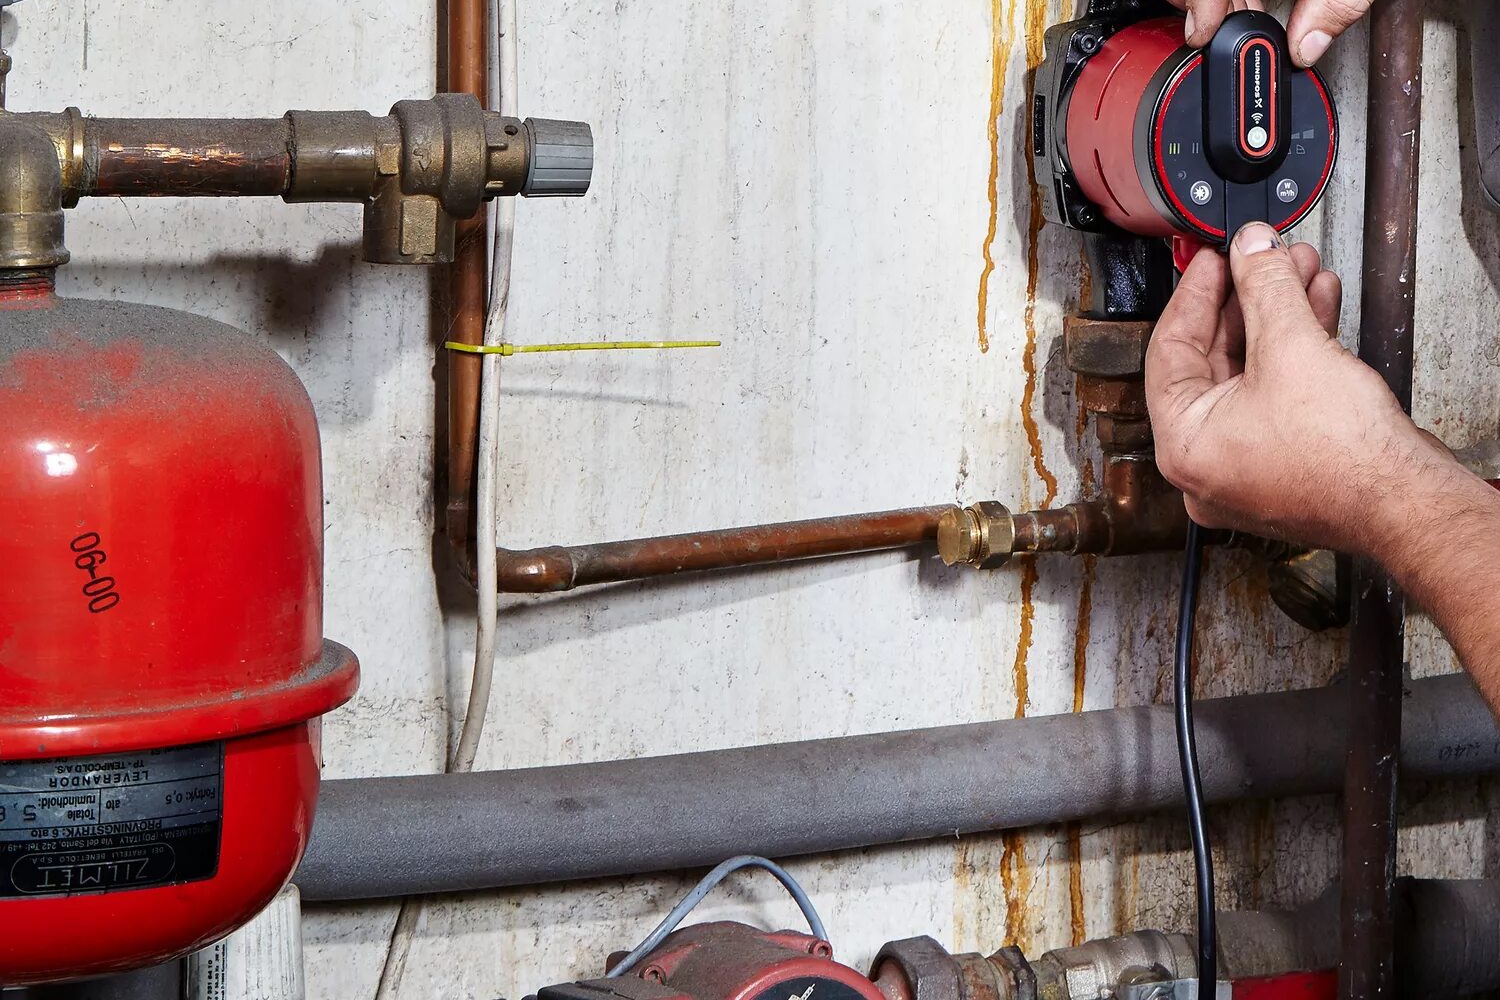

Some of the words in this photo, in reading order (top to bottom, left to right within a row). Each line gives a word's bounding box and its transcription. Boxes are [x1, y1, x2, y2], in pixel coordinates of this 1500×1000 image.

[75, 761, 126, 773] TEMPCOLD
[185, 787, 216, 803] Fortryk:
[38, 795, 96, 810] rumindhold:
[105, 799, 121, 810] ato
[67, 808, 96, 821] Totale
[31, 829, 50, 838] ato
[52, 829, 59, 838] 6
[120, 834, 142, 844] ITALY
[42, 841, 57, 850] 242
[86, 839, 99, 847] del
[36, 857, 149, 888] ZILMET
